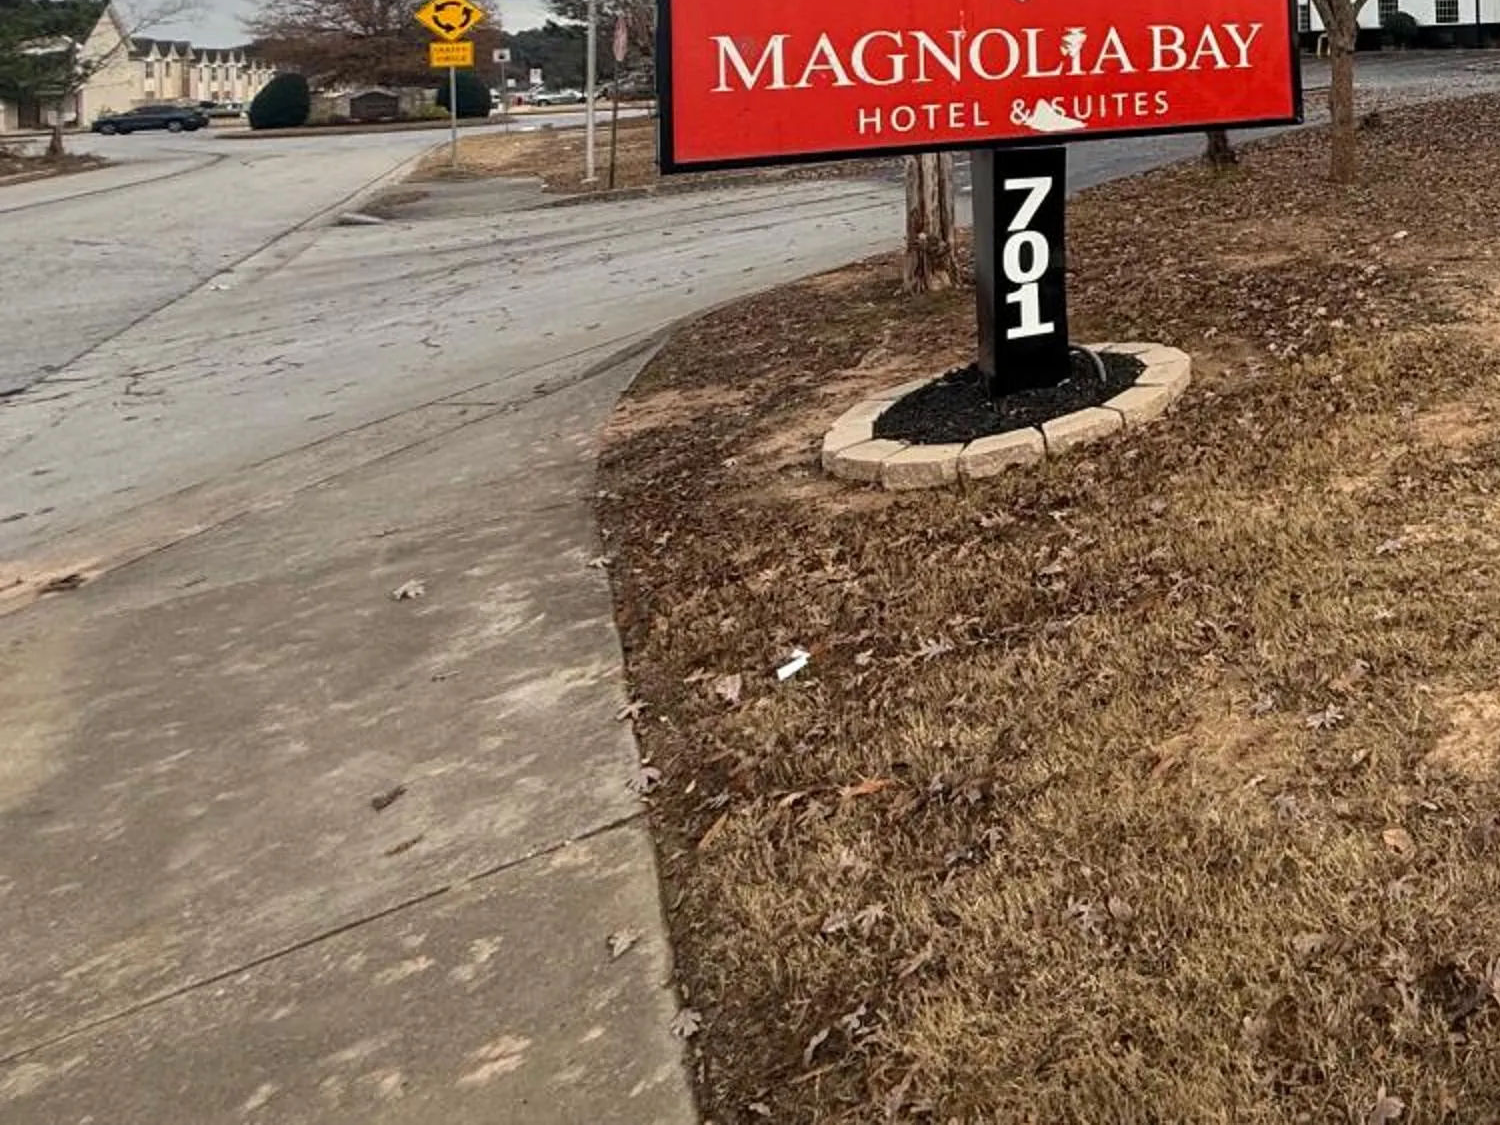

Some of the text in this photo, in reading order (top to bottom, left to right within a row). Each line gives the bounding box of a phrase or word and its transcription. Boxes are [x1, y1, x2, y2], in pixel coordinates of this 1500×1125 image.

[709, 23, 1263, 92] MAGNOLIA BAY
[858, 90, 1169, 134] HOTEL & SUITES
[1003, 176, 1055, 340] 701
